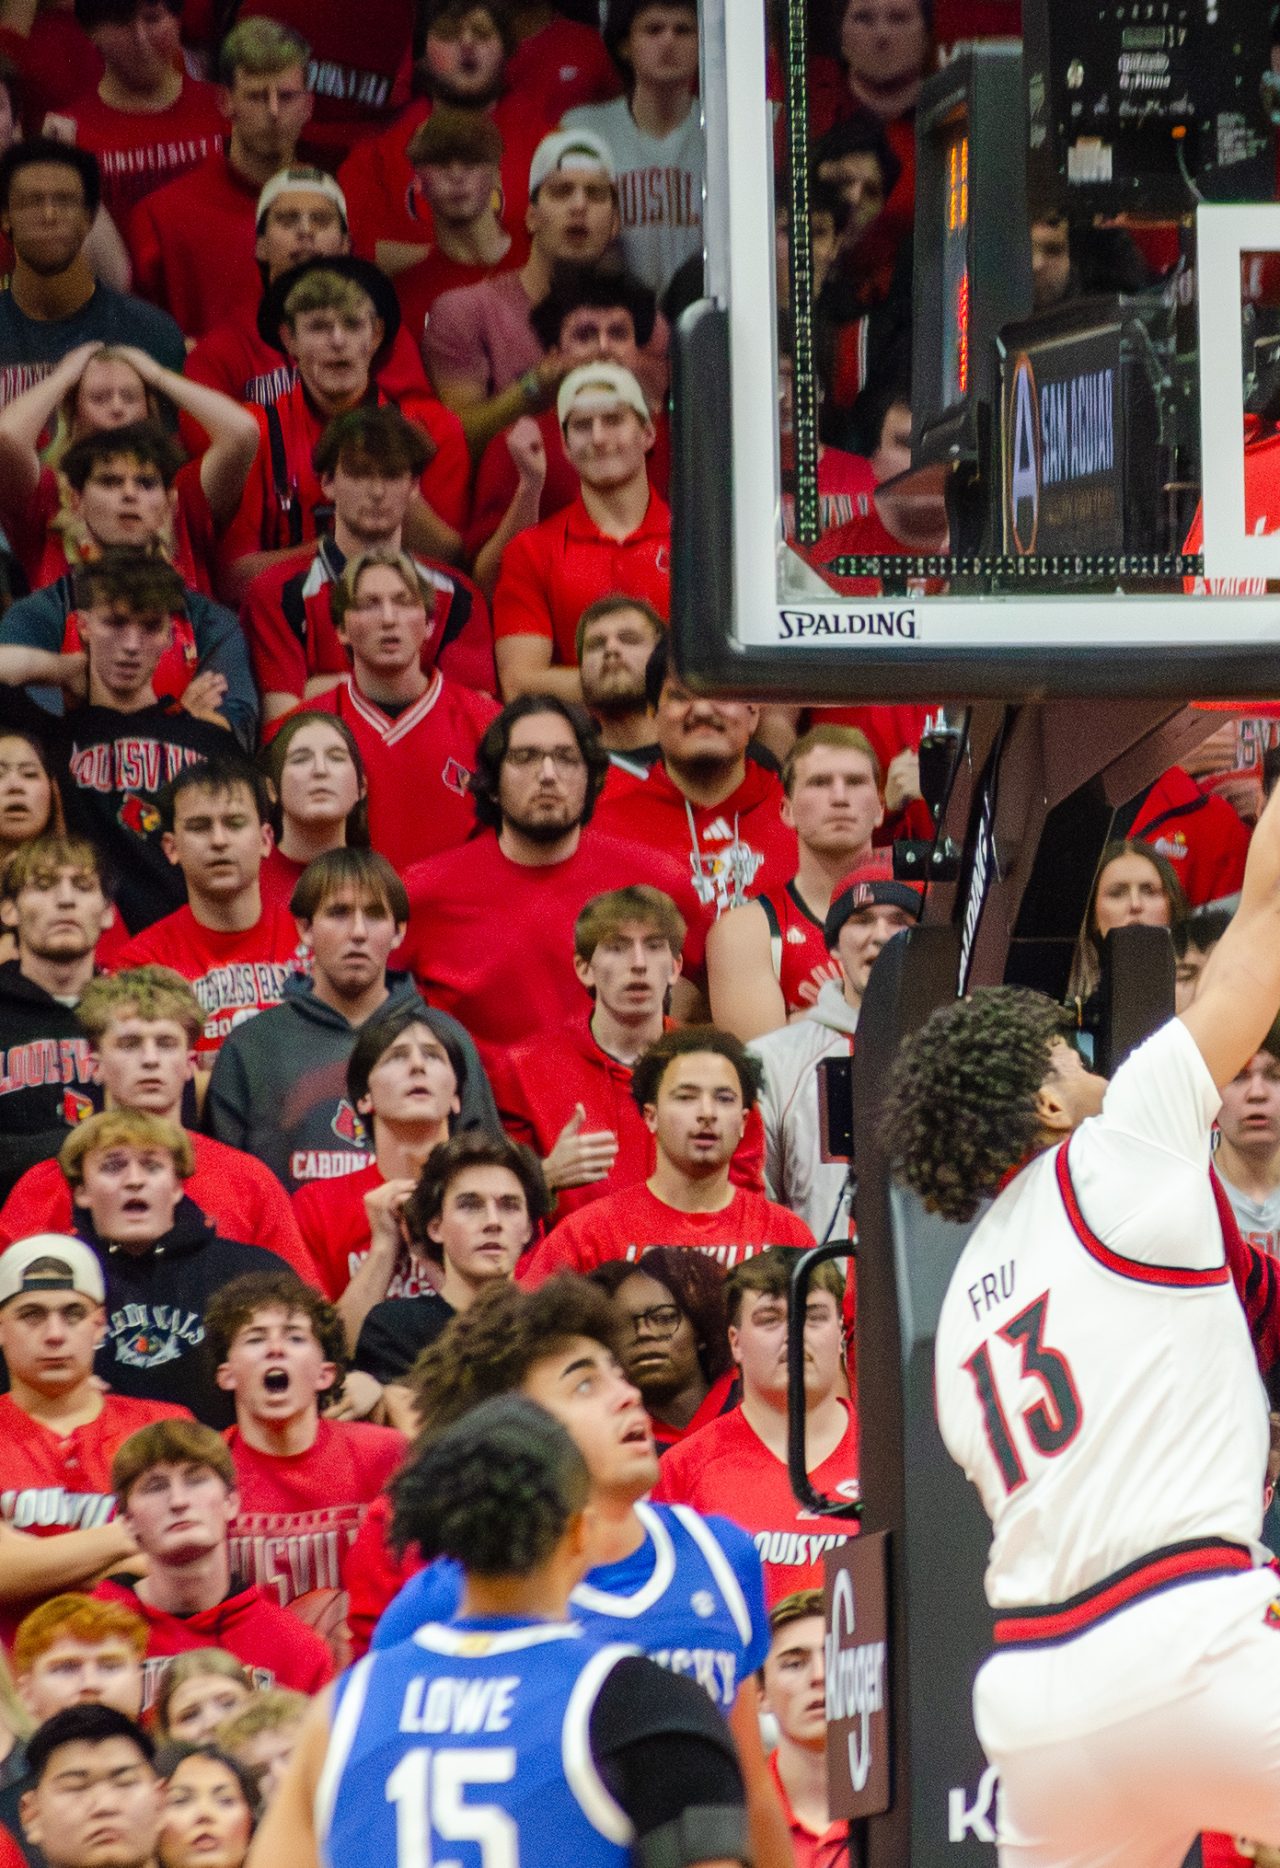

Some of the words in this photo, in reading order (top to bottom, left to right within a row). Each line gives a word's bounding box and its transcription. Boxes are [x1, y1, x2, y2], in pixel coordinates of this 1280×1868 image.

[1041, 381, 1069, 486] SAM
[1071, 368, 1114, 478] AGUIAR
[777, 608, 917, 640] SPALDING
[967, 1259, 1016, 1323] FRU
[960, 1287, 1084, 1498] 13
[399, 1676, 521, 1734] LOWE
[825, 1567, 885, 1793] Kroger
[385, 1747, 520, 1868] 15
